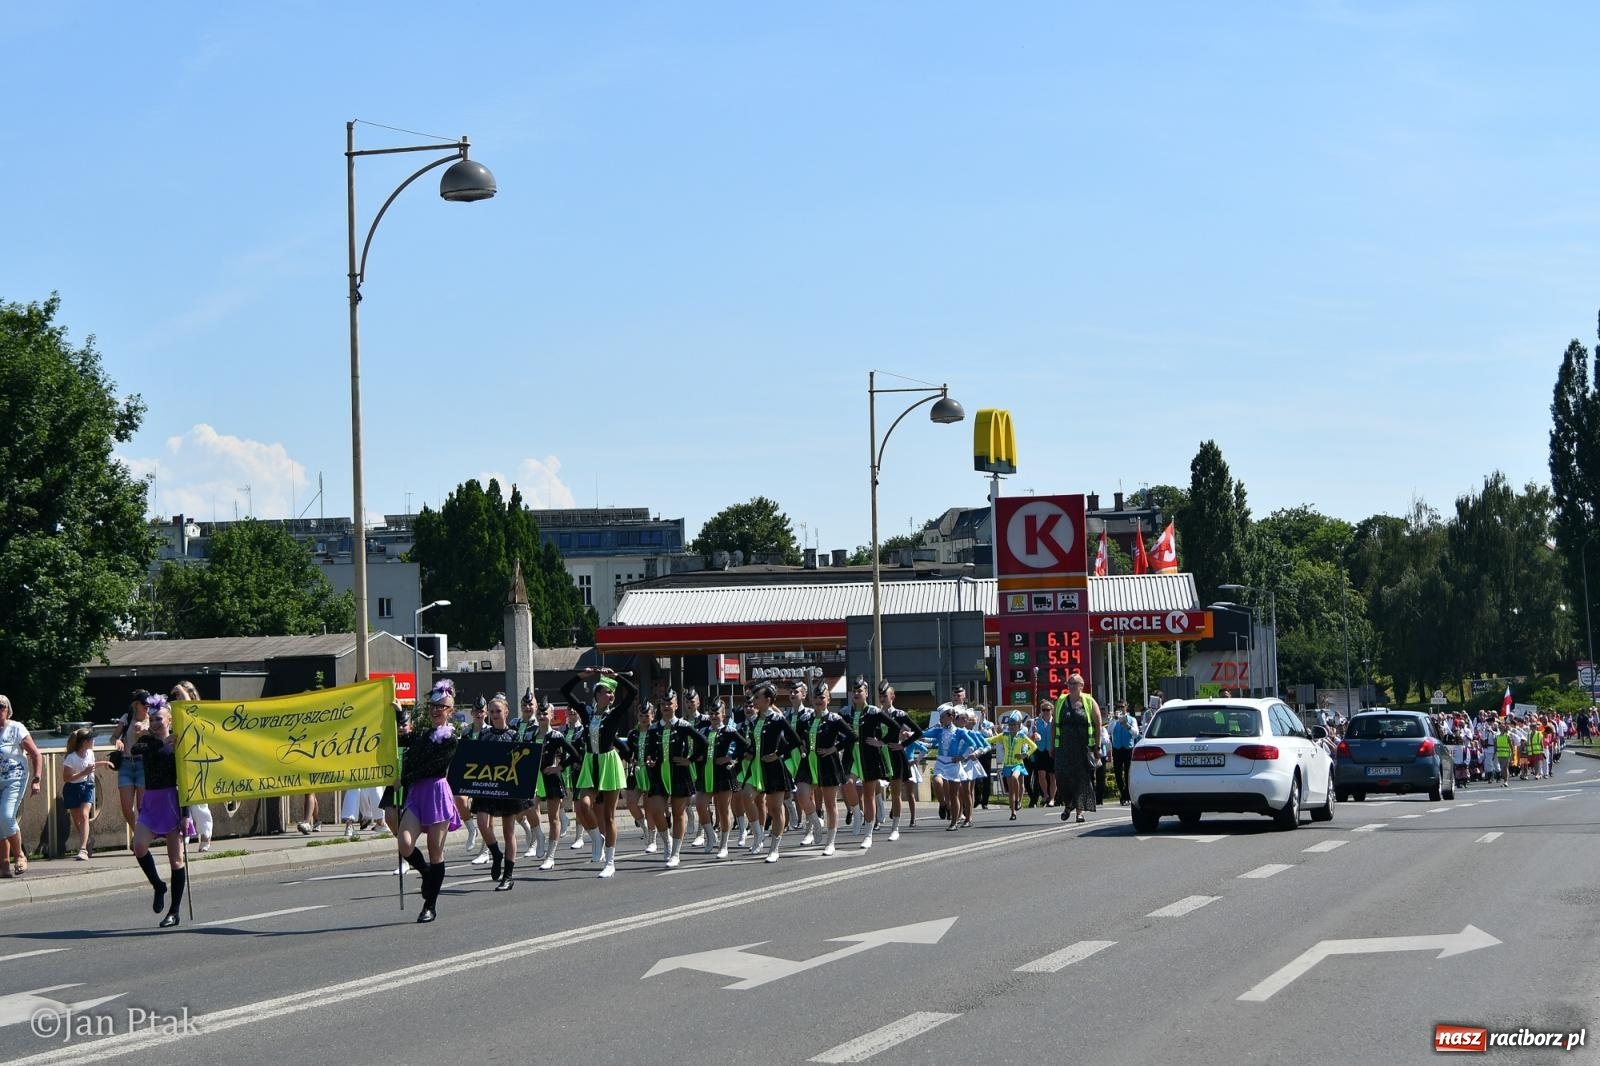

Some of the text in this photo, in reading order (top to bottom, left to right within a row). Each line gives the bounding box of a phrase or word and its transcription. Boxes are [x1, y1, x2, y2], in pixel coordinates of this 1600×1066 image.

[1023, 514, 1071, 567] K
[1100, 615, 1187, 632] CIRCLE K
[1014, 631, 1081, 647] D 6.12
[1013, 650, 1081, 665] 95 5.94
[1016, 670, 1024, 679] D
[1210, 660, 1250, 681] ZDZ
[1014, 690, 1027, 699] 95
[221, 701, 354, 732] Stowarzyszenie
[275, 726, 382, 765] Źródło
[1181, 755, 1222, 766] SRC HX15
[212, 763, 395, 796] ŚLĄSK KRAINA WIELU KULTUR
[463, 757, 520, 786] ZARA
